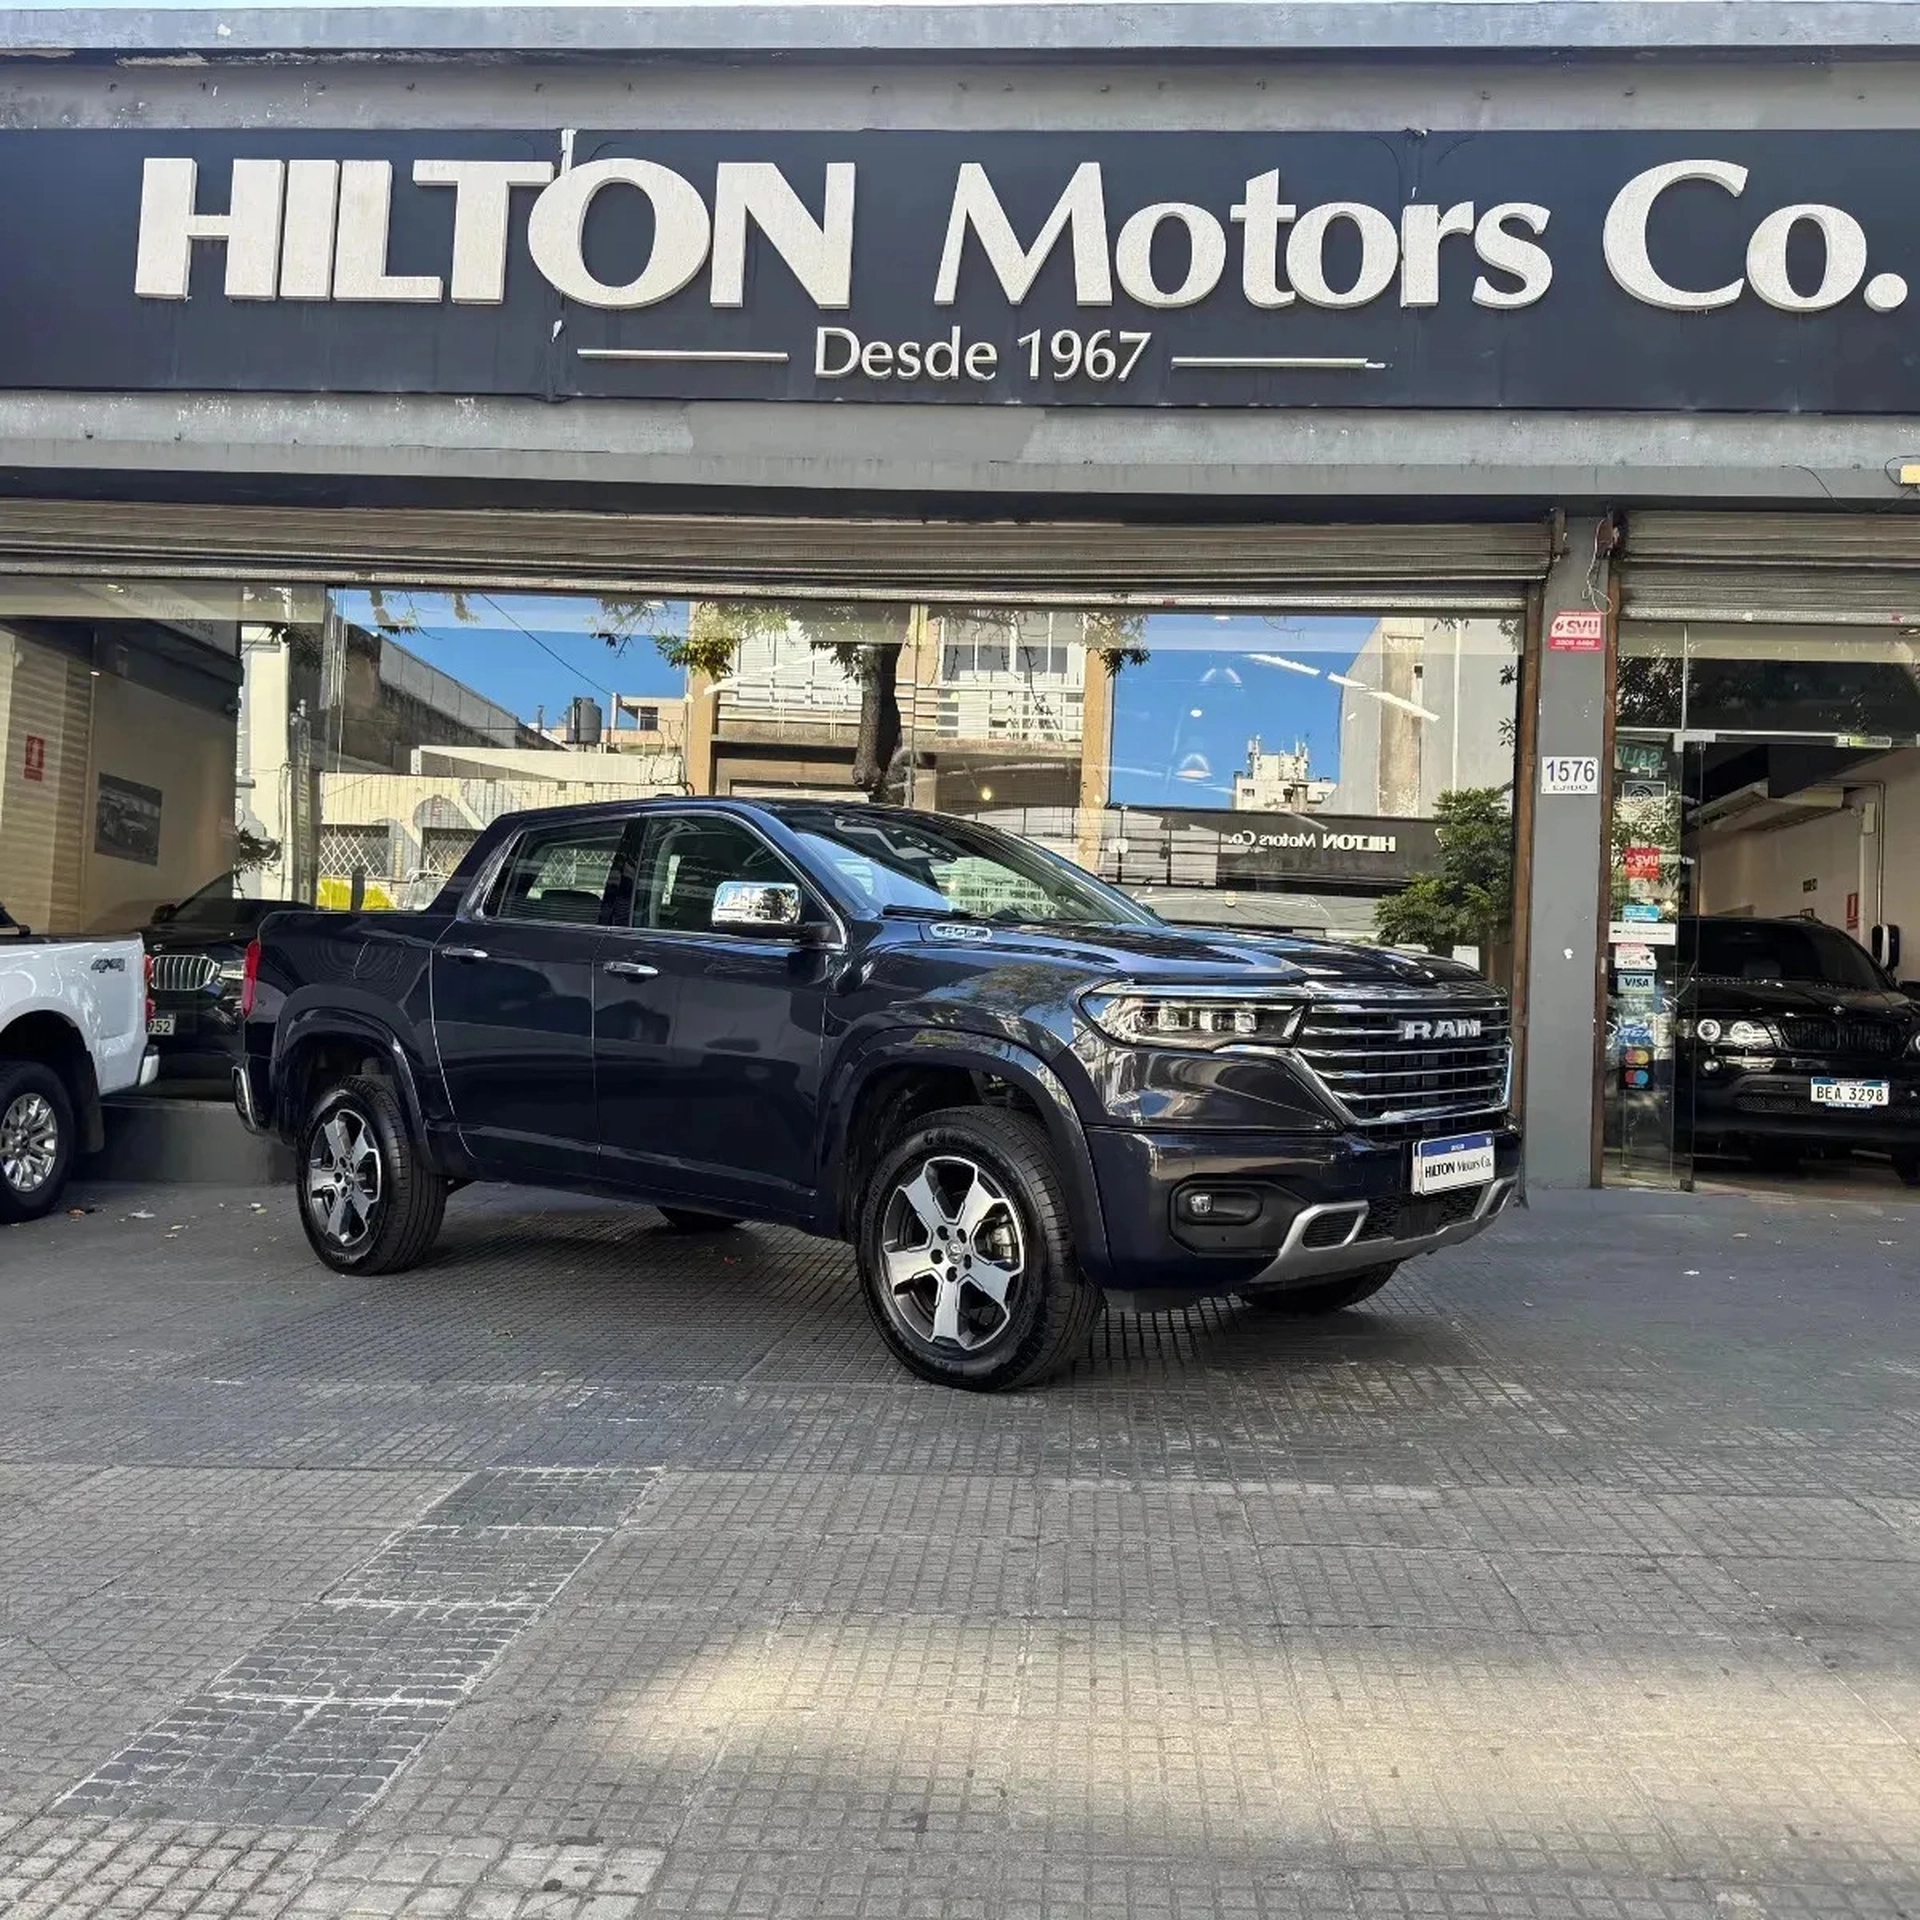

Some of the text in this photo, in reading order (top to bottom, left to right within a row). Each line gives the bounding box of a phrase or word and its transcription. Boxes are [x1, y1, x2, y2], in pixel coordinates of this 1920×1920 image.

[134, 157, 1909, 313] HILTON Motors Co.
[815, 325, 1152, 382] Desde 1967
[1566, 620, 1598, 635] SVU
[1546, 760, 1595, 782] 1576
[1623, 978, 1650, 987] VISA
[1399, 1019, 1481, 1040] RAM
[1816, 1086, 1884, 1102] BEA 3298
[1425, 1161, 1456, 1179] HILTON
